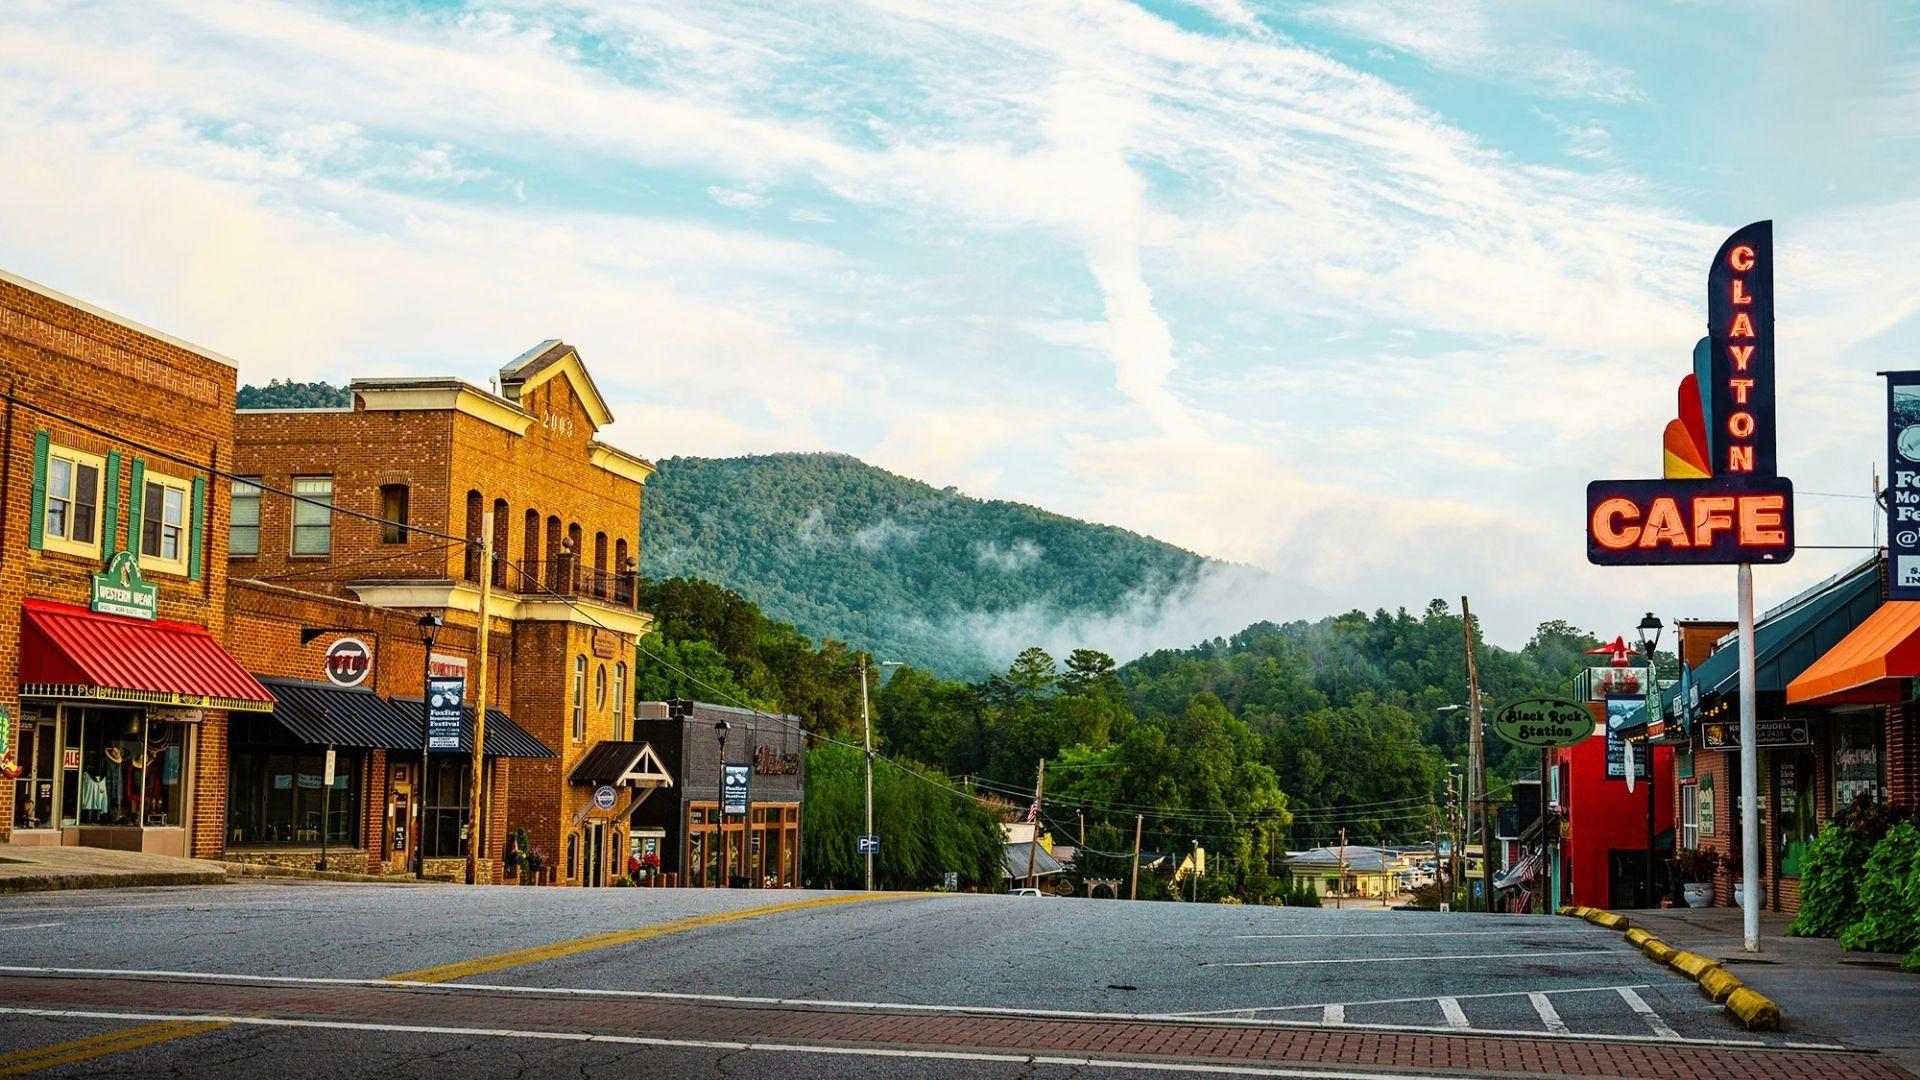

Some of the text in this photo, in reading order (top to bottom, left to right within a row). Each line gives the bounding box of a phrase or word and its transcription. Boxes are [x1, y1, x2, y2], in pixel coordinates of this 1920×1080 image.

[1729, 245, 1755, 471] CLAYTON
[1592, 495, 1786, 548] CAFE
[99, 586, 153, 608] WESTERN WEAR
[1505, 710, 1583, 725] Black Rock
[1519, 724, 1573, 740] Station
[64, 751, 80, 766] ALE
[860, 839, 869, 851] P
